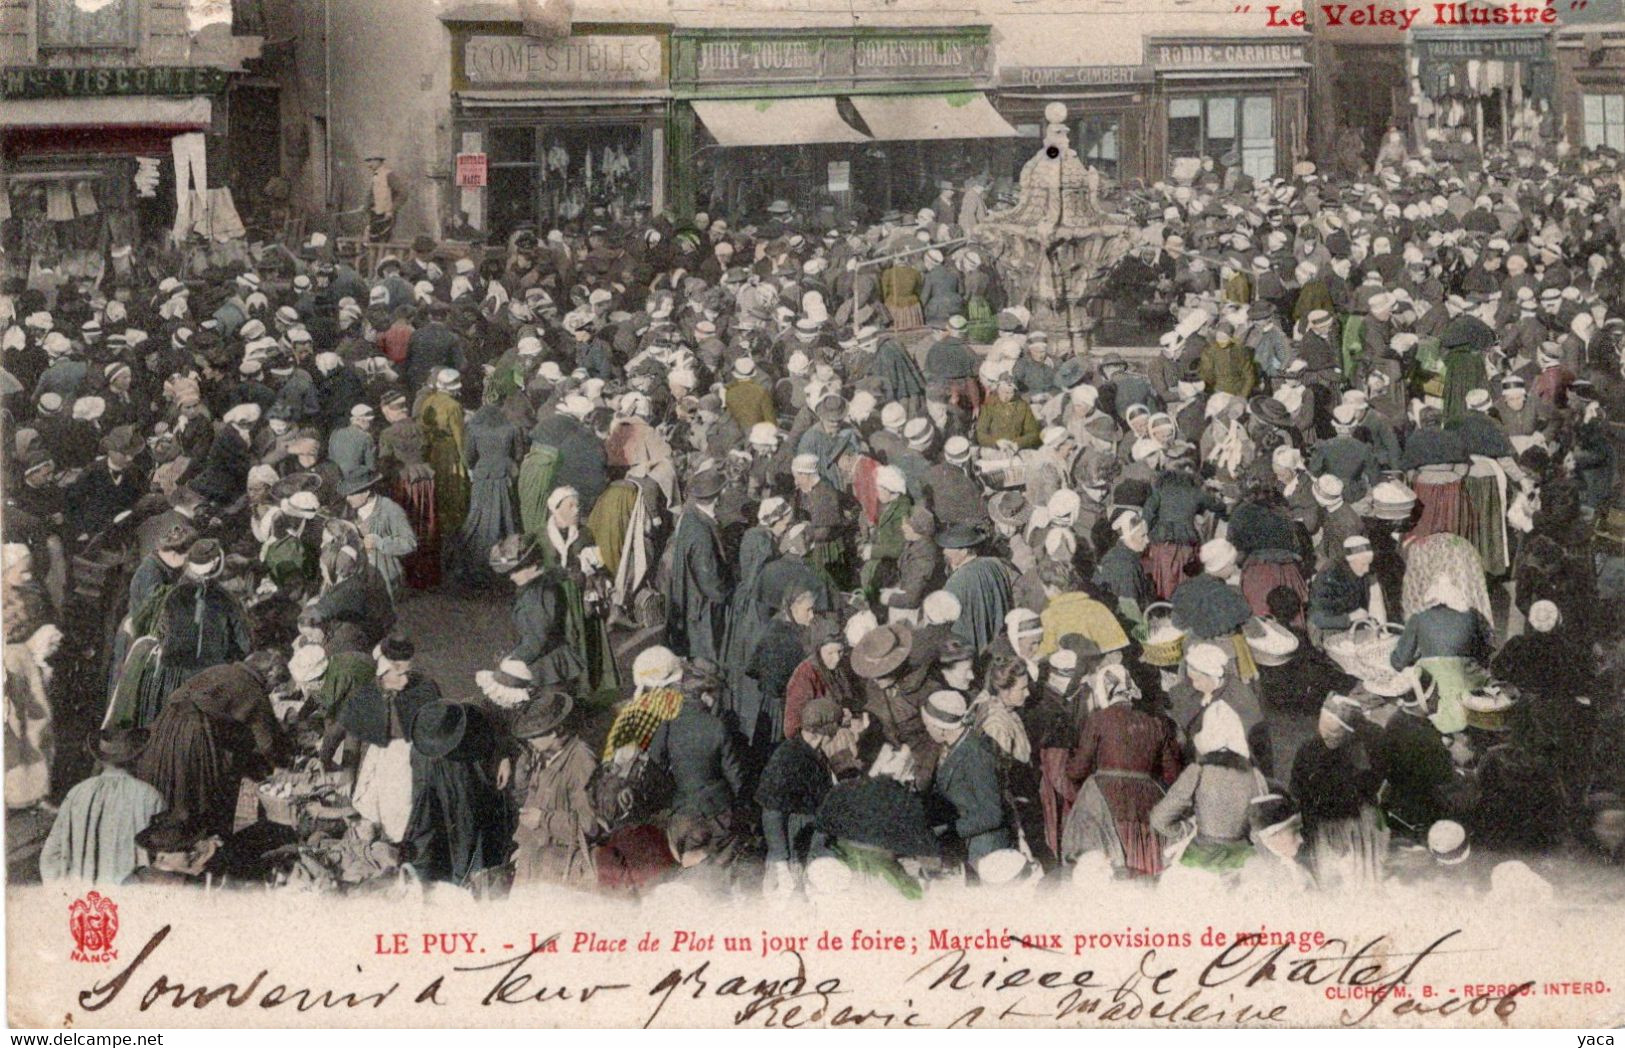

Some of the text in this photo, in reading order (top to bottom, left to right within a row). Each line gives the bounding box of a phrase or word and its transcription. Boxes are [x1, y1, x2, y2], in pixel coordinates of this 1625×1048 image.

[471, 42, 650, 74] COMESTIBLES
[79, 925, 399, 1012] Souvenir
[644, 949, 853, 1029] grande
